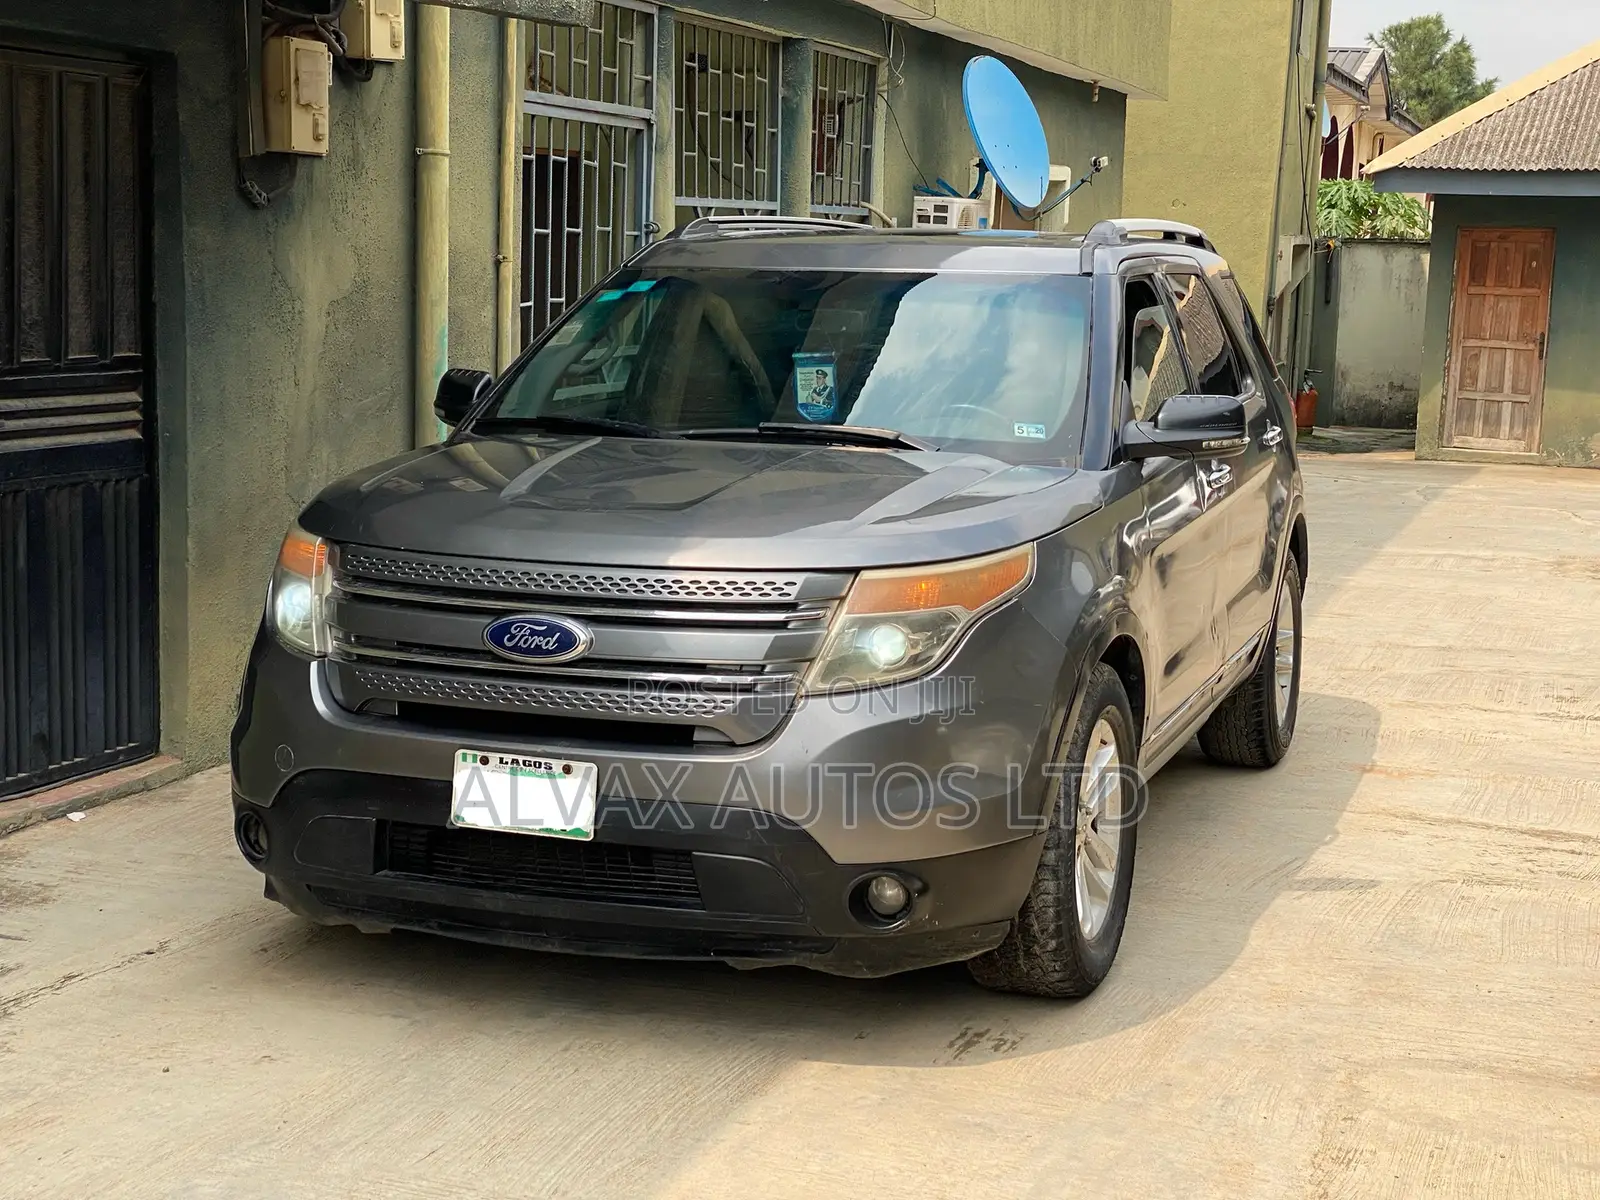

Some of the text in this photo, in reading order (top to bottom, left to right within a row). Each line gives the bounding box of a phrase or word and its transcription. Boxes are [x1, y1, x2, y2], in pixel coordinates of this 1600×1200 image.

[1017, 426, 1025, 435] 5
[503, 622, 561, 651] Ford
[498, 757, 553, 771] LAGOS
